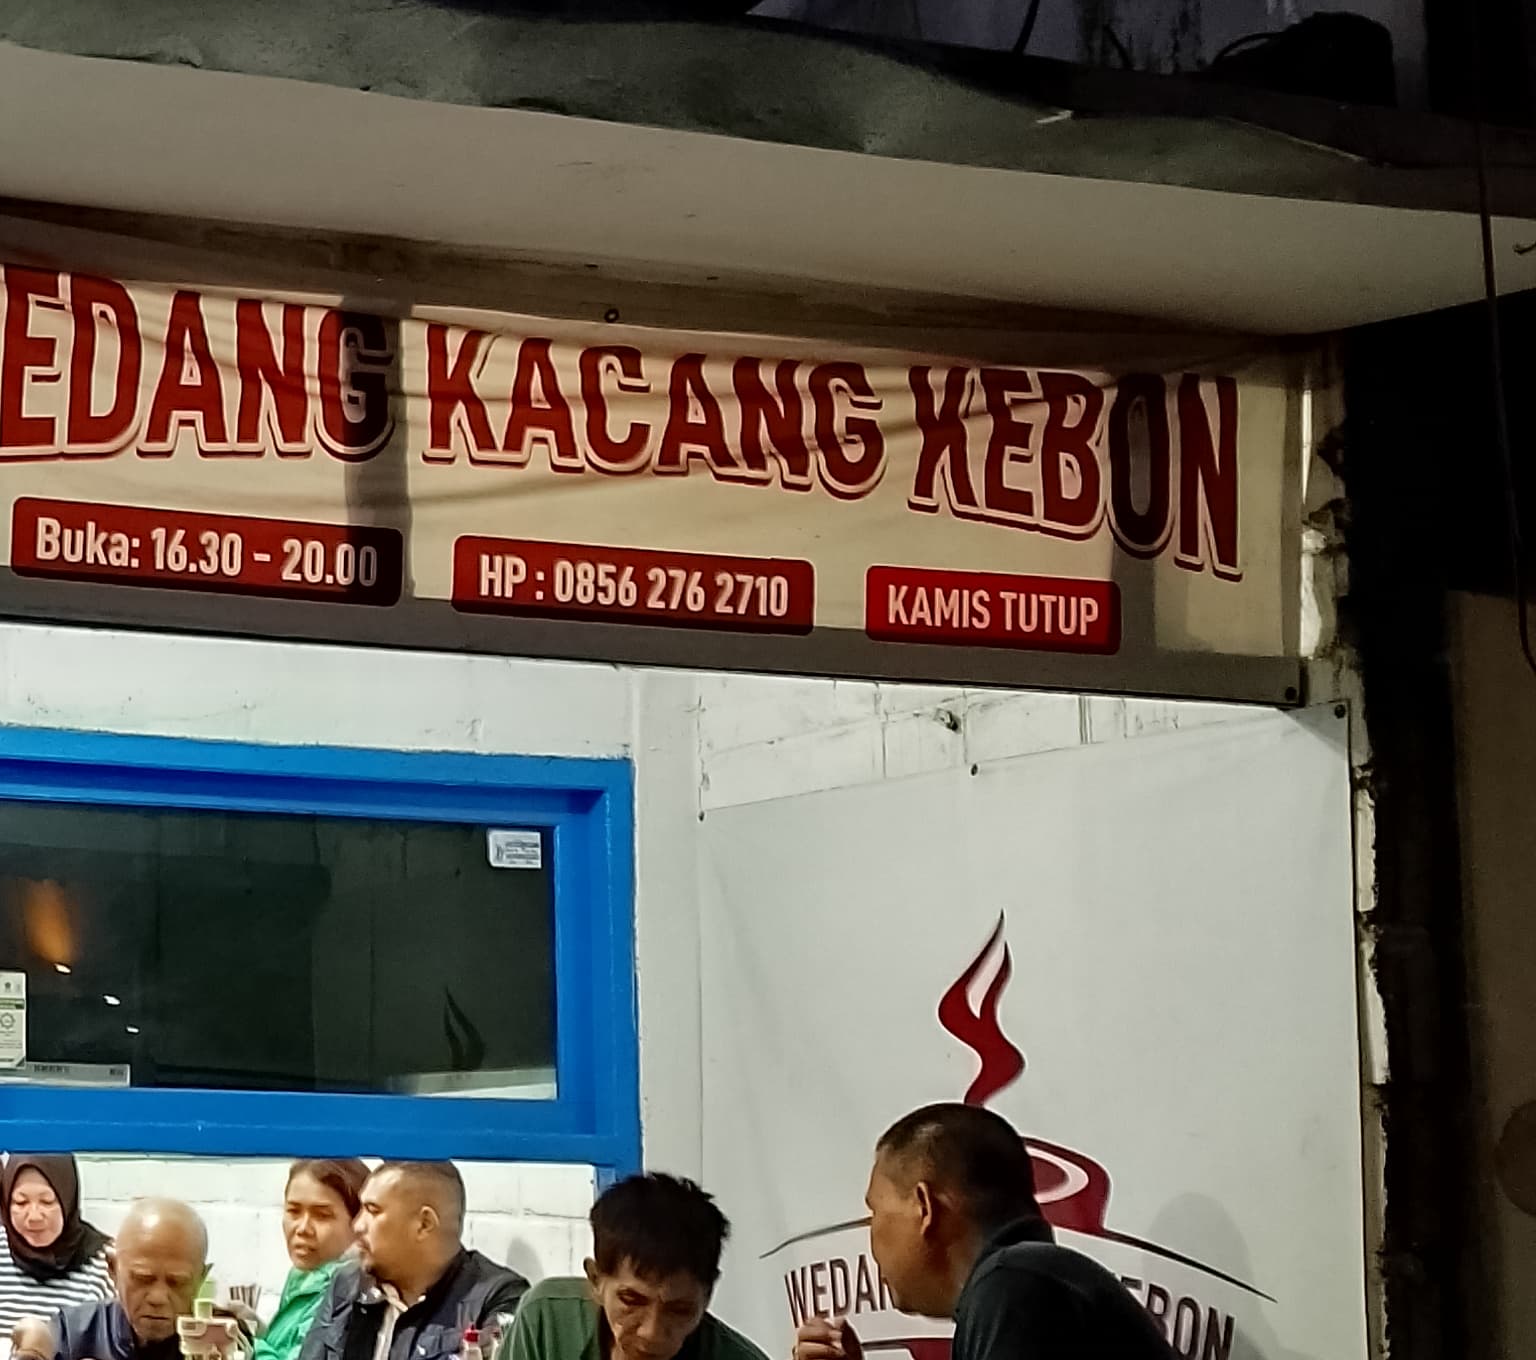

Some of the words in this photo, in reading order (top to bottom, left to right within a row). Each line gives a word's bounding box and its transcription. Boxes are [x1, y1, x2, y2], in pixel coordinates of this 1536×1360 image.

[421, 322, 889, 501] KACANG
[906, 365, 1244, 584] KEBON
[35, 515, 141, 569] Buka:
[150, 526, 243, 577] 16.30
[280, 537, 378, 588] 20.00
[552, 559, 638, 608] 0856
[645, 566, 706, 613] 276
[714, 571, 790, 617] 2710
[887, 583, 992, 630] KAMIS
[998, 590, 1100, 637] TUTUP
